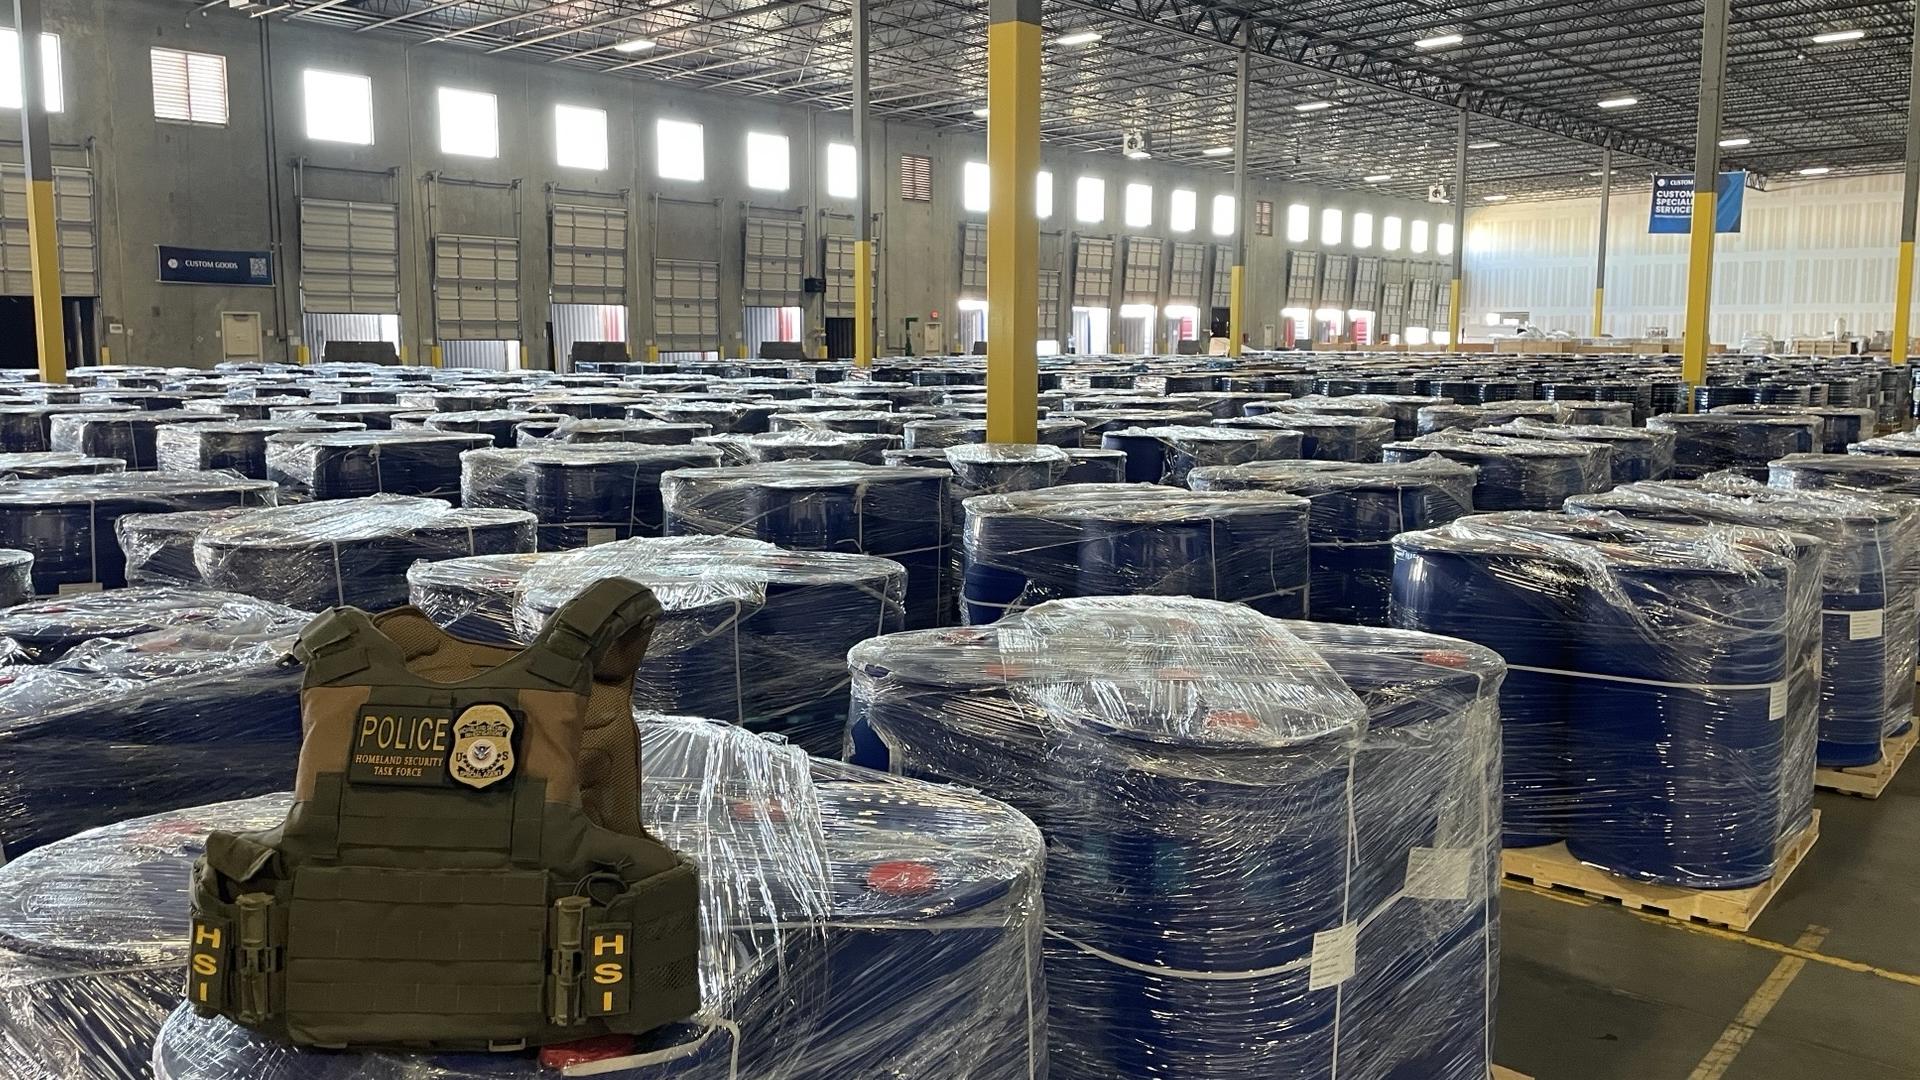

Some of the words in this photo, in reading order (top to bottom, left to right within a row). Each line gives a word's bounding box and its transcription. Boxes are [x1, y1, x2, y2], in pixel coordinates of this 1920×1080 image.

[1656, 190, 1694, 198] CUSTOM
[1655, 206, 1692, 214] SERVICE
[185, 260, 214, 268] CUSTOM
[215, 261, 238, 269] GOODS
[360, 715, 449, 751] POLICE
[355, 754, 402, 765] HOMELAND
[403, 756, 444, 767] SECURITY
[374, 766, 393, 776] TASK
[395, 767, 422, 777] FORCE
[193, 924, 221, 1002] HSI
[593, 934, 624, 1011] HSI
